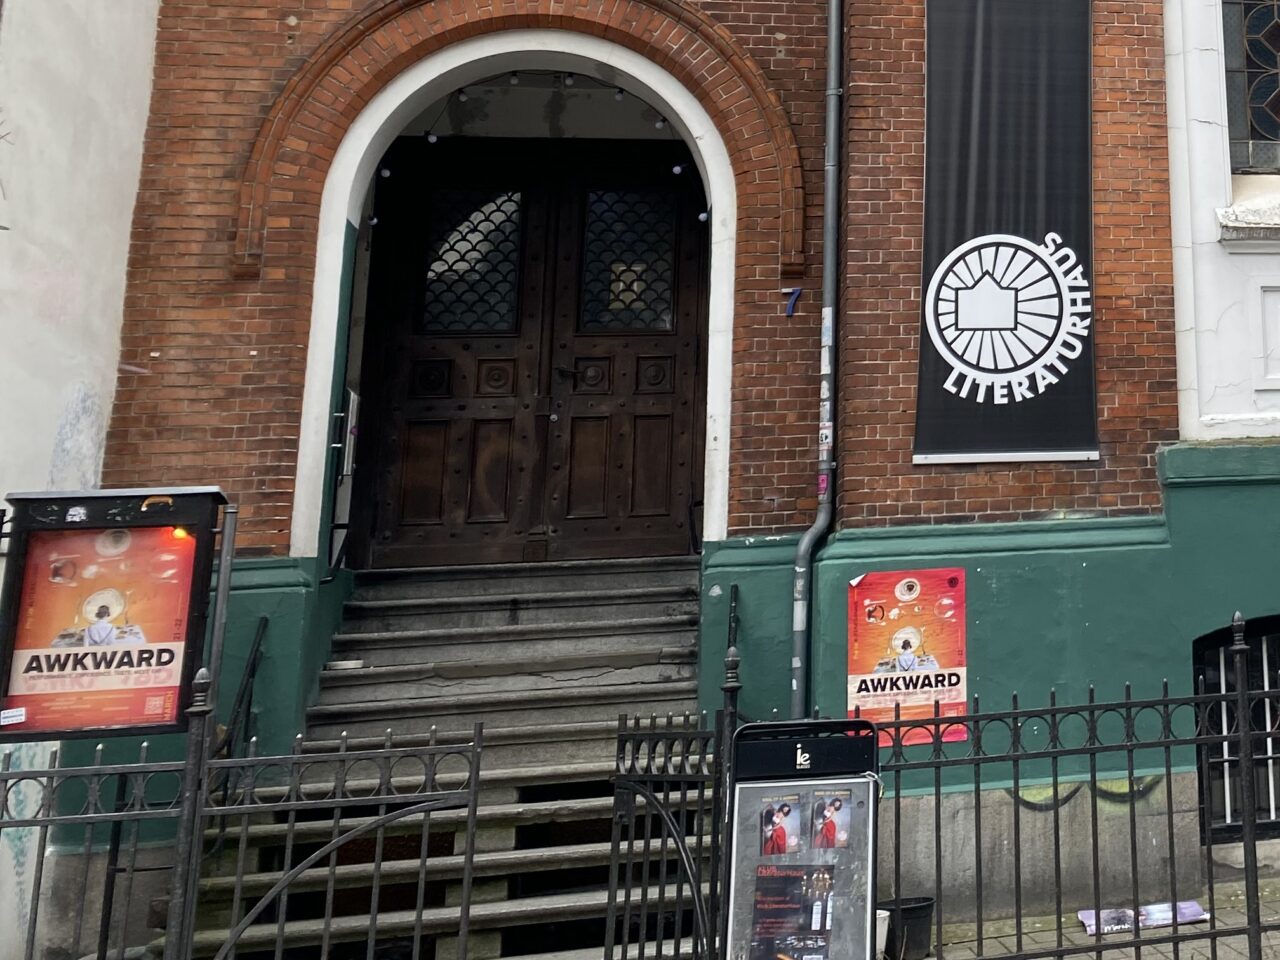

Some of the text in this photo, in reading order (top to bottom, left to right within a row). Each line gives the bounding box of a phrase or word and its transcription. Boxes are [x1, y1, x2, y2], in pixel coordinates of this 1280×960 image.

[781, 288, 802, 317] 7
[943, 231, 1092, 405] LITERATURHAUS
[22, 648, 175, 674] AWKWARD
[856, 672, 961, 693] AWKWARD
[164, 690, 175, 721] MARCH
